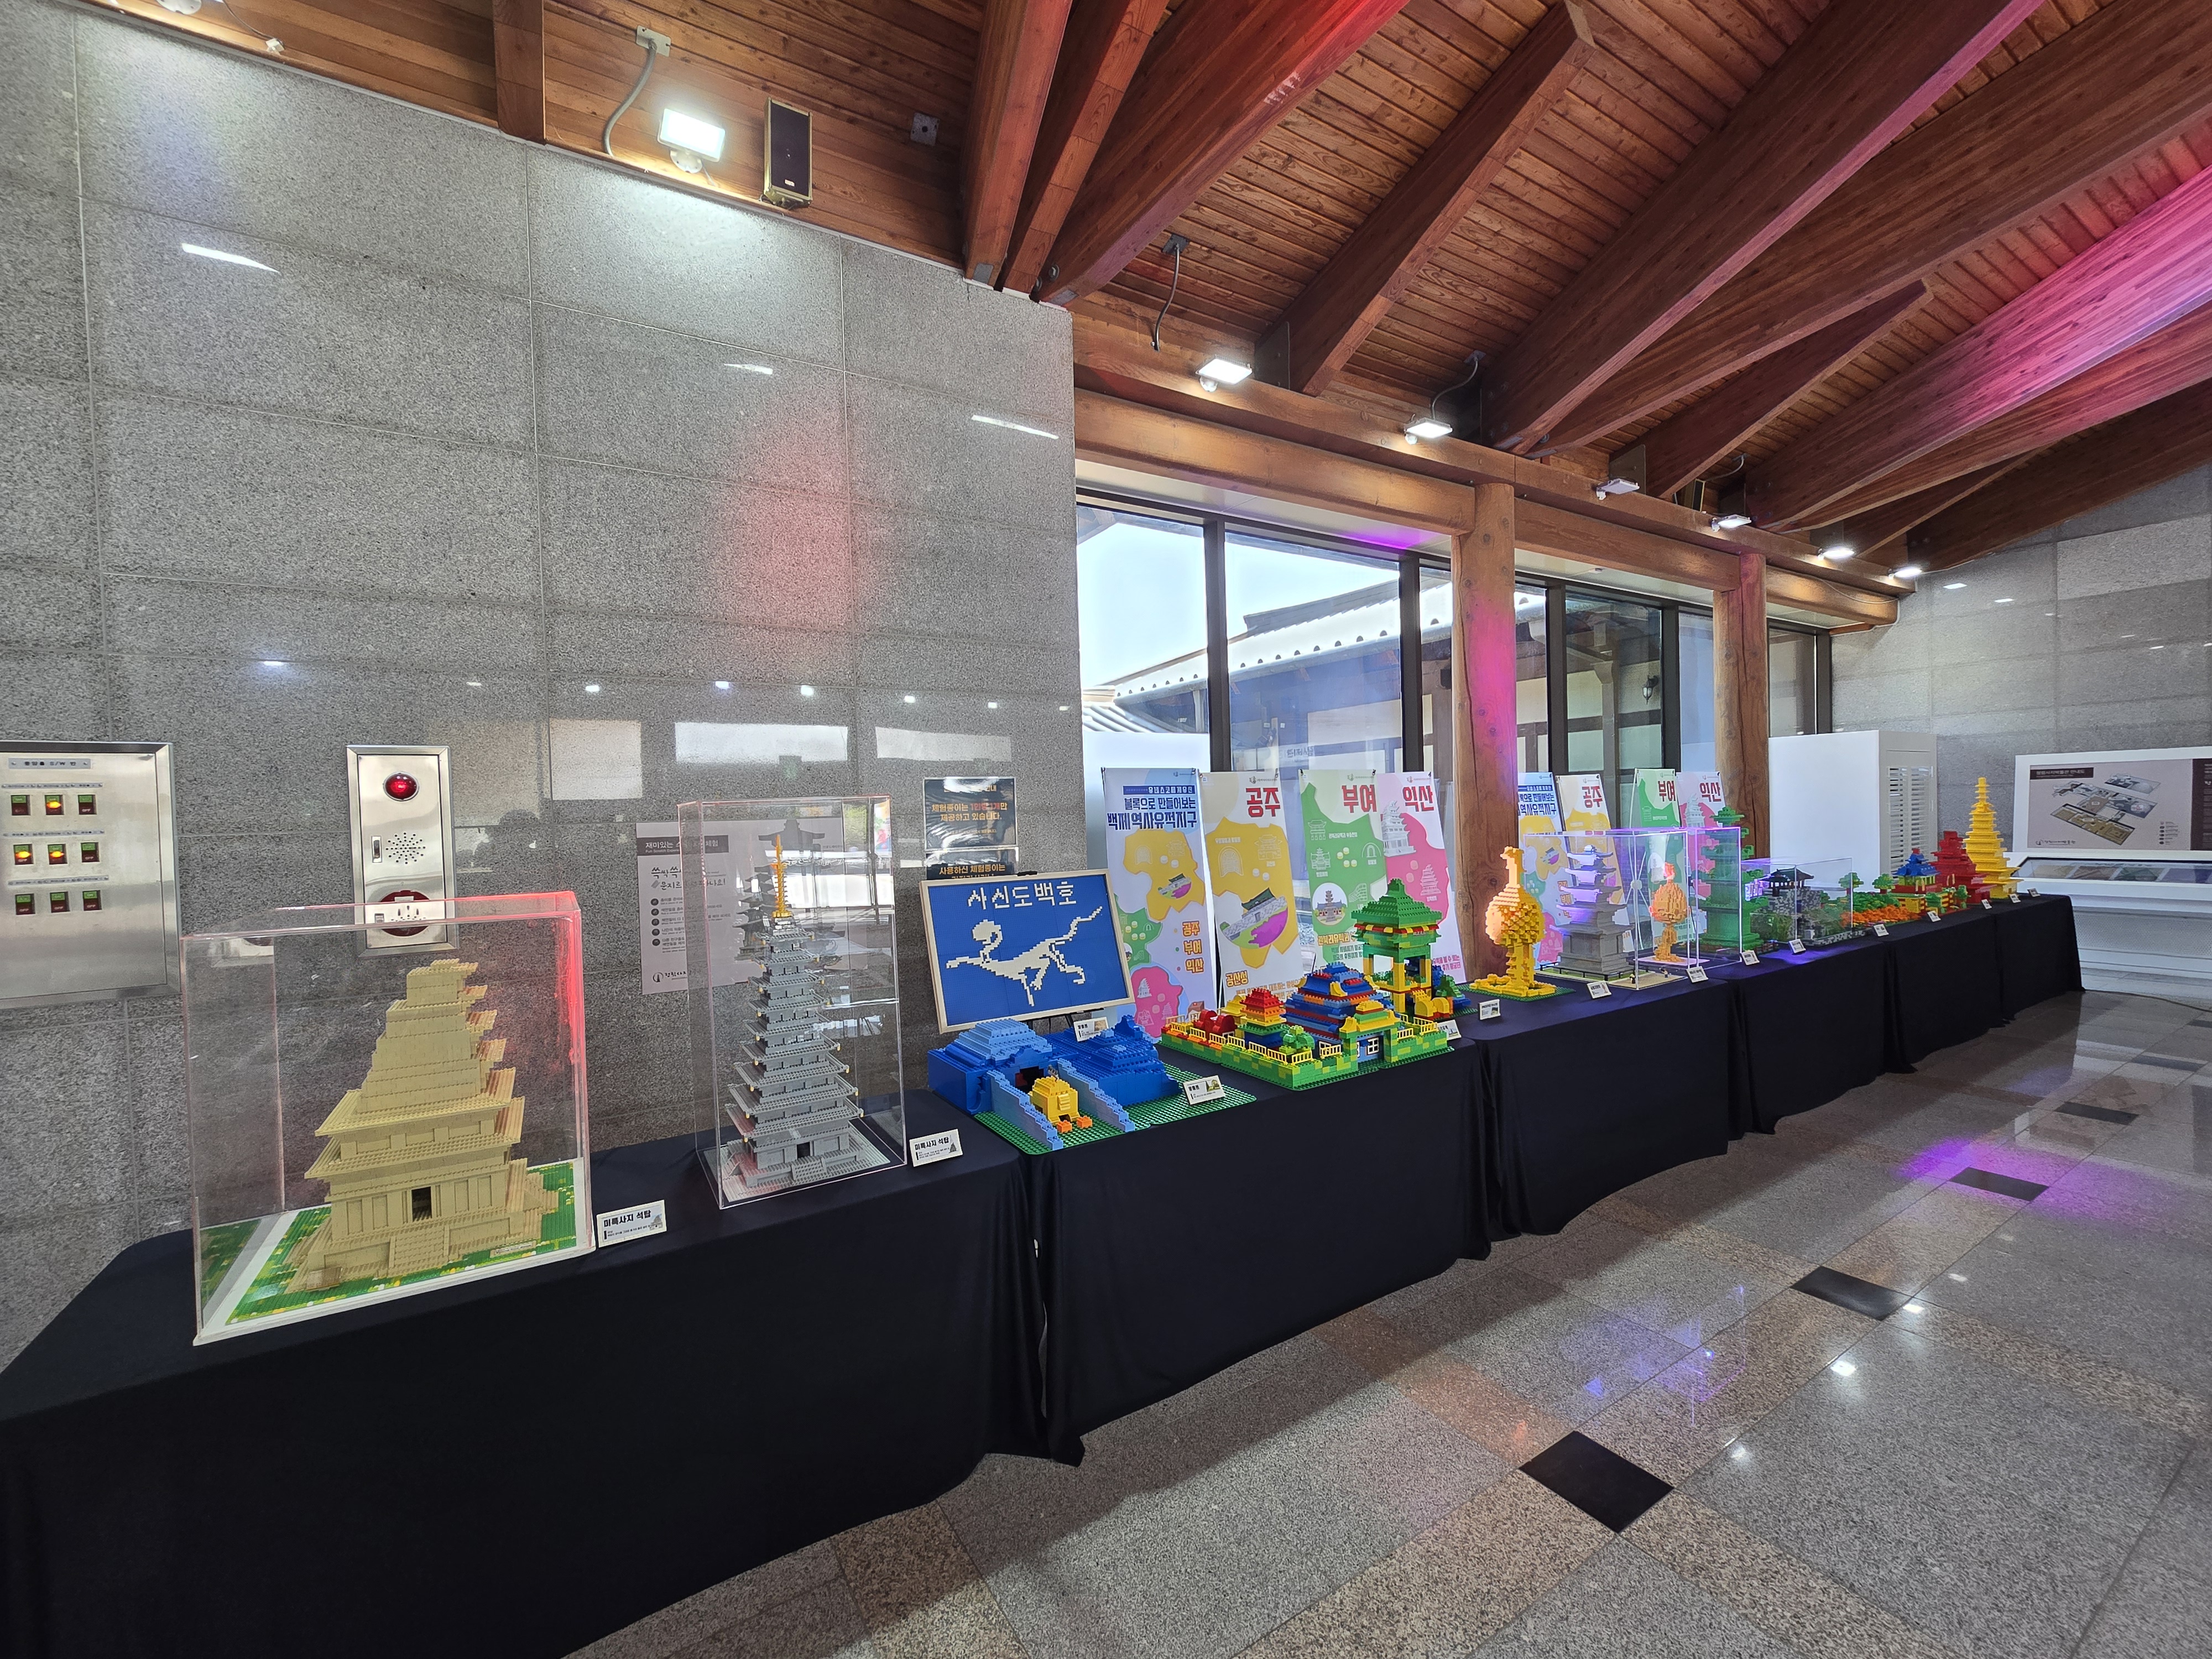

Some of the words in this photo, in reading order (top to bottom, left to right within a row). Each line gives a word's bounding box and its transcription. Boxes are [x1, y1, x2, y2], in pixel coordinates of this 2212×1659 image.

[1342, 784, 1377, 813] 부여
[1402, 785, 1434, 812] 익산
[1582, 786, 1603, 808] 공주
[1658, 780, 1676, 802] 부여
[1699, 782, 1721, 802] 익산
[932, 803, 969, 812] 체험종이는
[1124, 798, 1156, 811] 블록으로
[1157, 797, 1196, 810] 만들어보는
[1245, 787, 1281, 818] 공주
[972, 812, 1002, 821] 있습니다.
[1107, 811, 1197, 830] 백제역사유적지구
[651, 866, 681, 879] 쓱싹쓱
[971, 864, 1005, 873] 체험종이는
[660, 881, 682, 890] 문지르
[968, 881, 1077, 910] 사신도백호
[1182, 921, 1200, 937] 공주
[1183, 939, 1202, 955] 부여
[1186, 957, 1204, 973] 익산
[1225, 971, 1249, 987] 공산성
[603, 1213, 634, 1227] 미륵사지
[636, 1209, 651, 1219] 석탑
